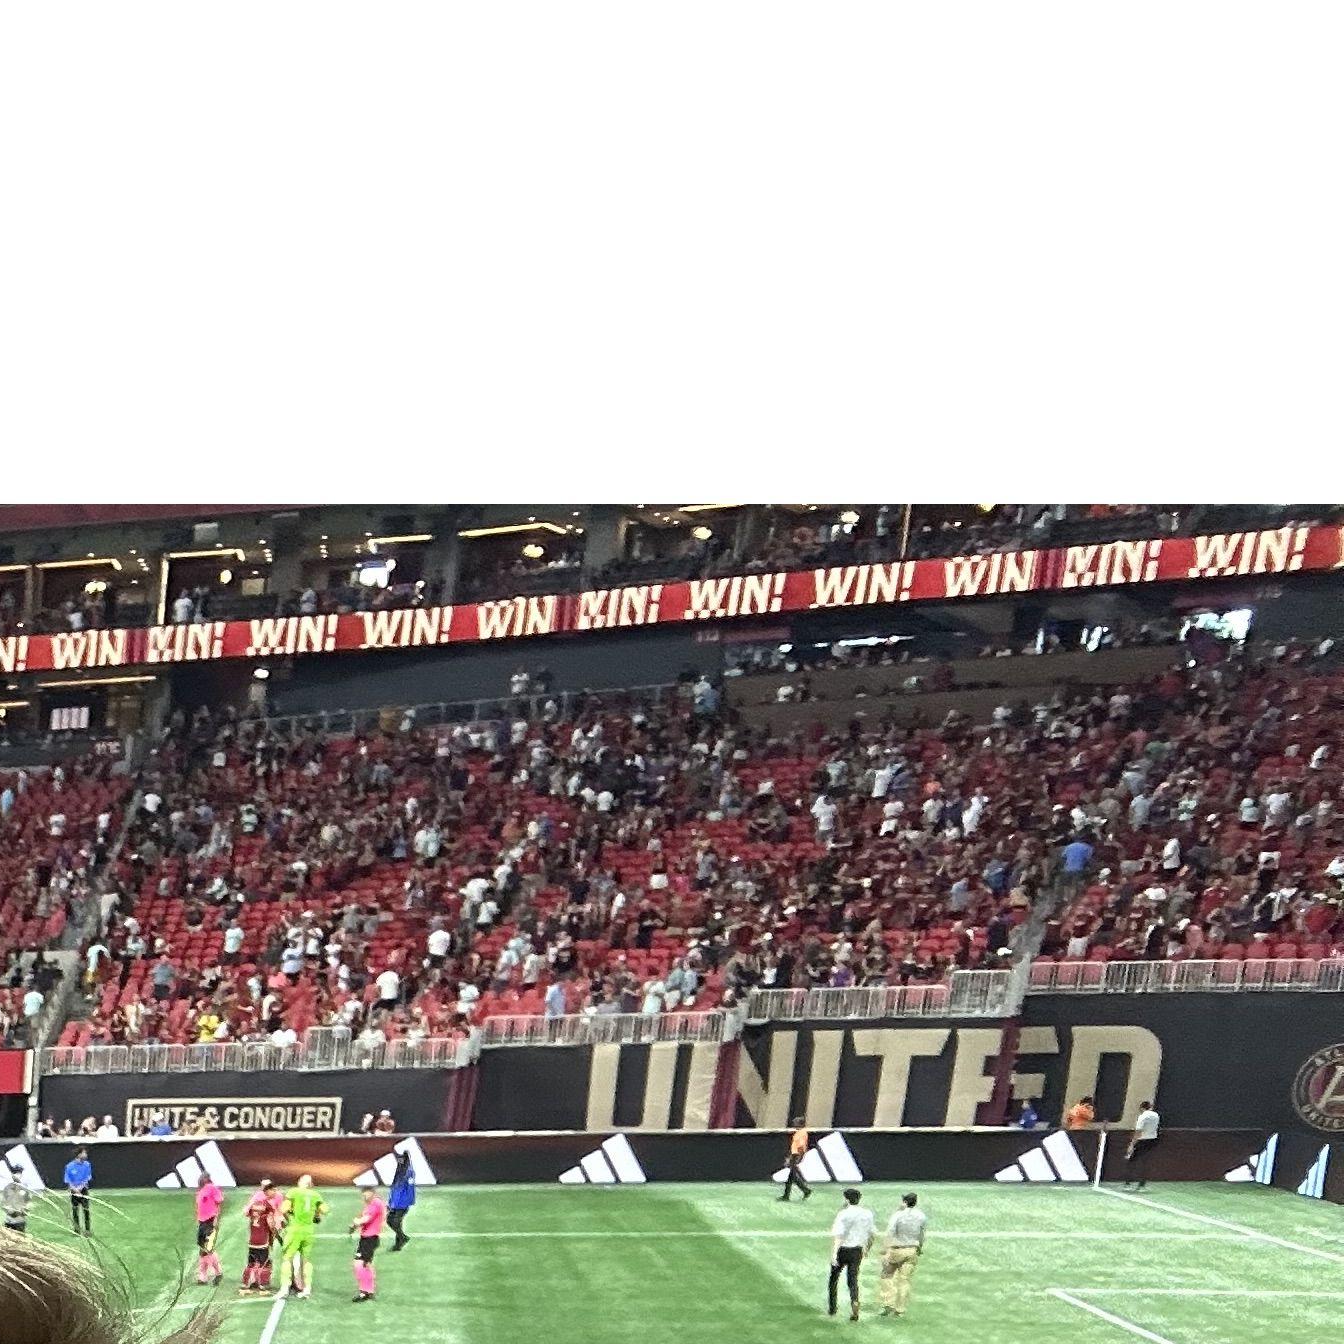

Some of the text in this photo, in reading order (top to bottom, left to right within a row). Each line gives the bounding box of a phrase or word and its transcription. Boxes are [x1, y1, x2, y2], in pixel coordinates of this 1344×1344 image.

[246, 616, 338, 655] WIN!
[360, 607, 453, 647] WIN!
[684, 574, 786, 618] WIN!
[811, 562, 915, 607] WIN!
[1188, 528, 1308, 577] WIN!
[204, 1106, 220, 1128] &
[224, 1106, 334, 1129] CONQUER
[586, 1026, 1163, 1131] UNITED
